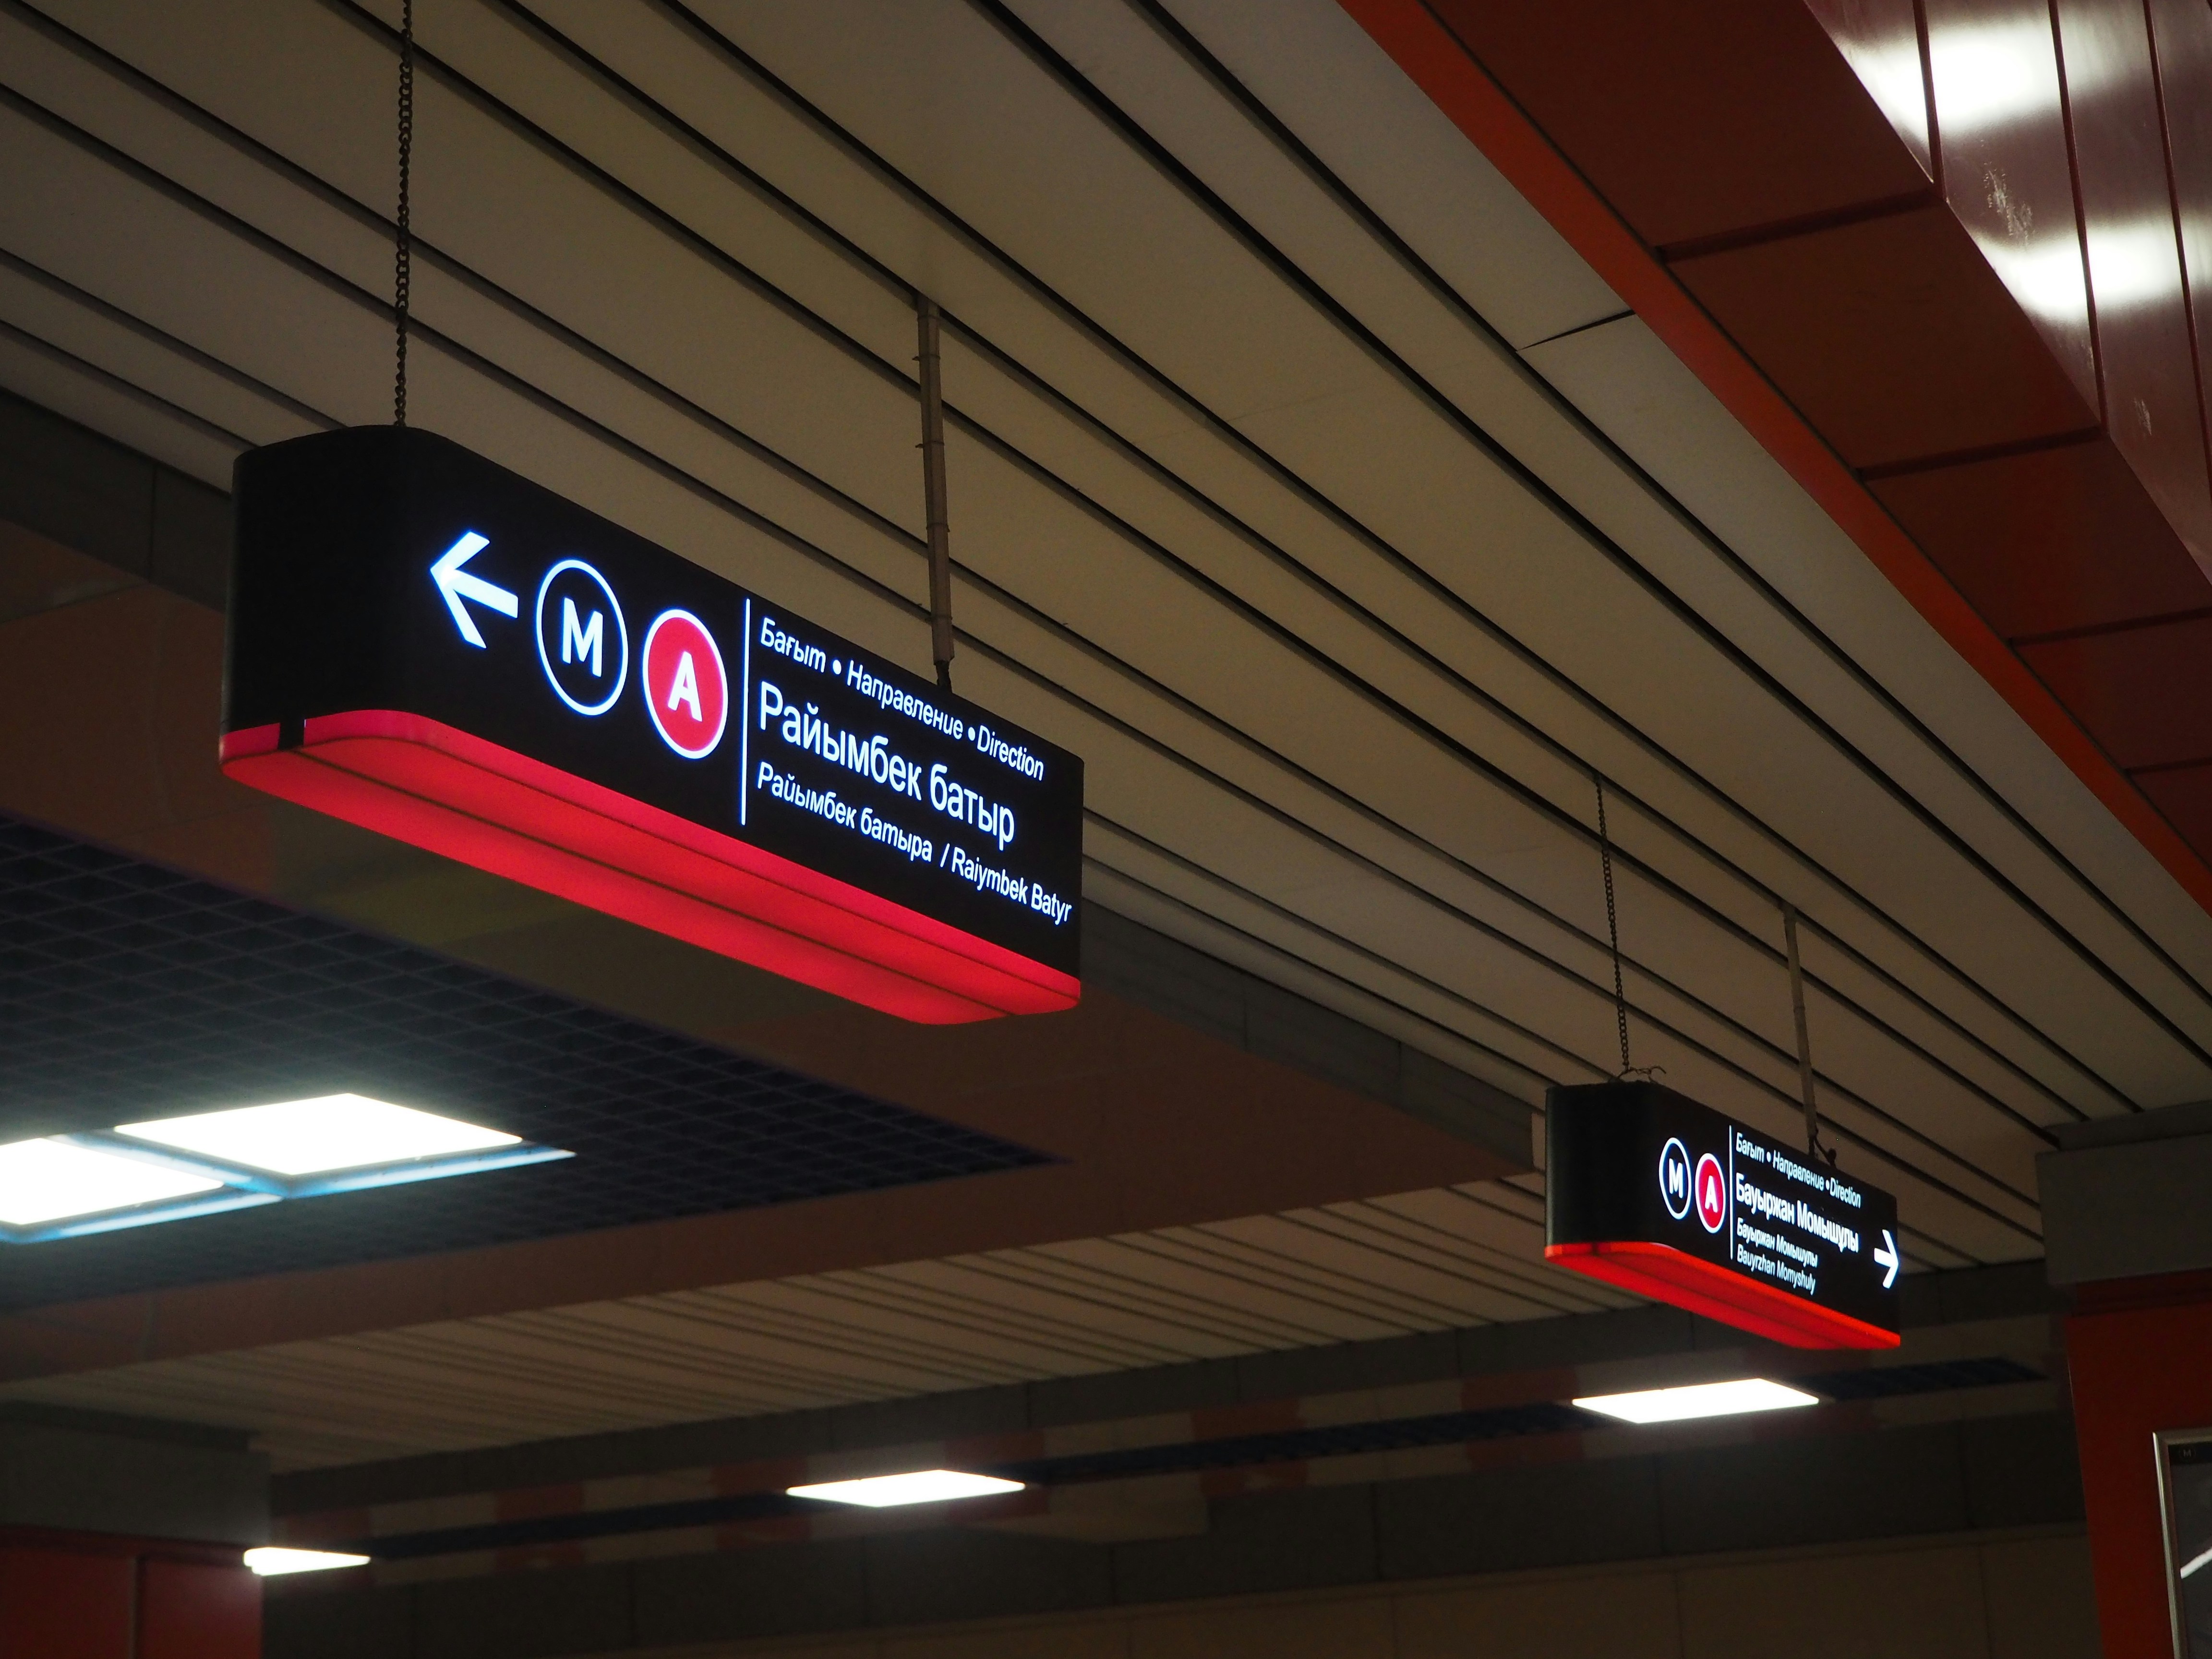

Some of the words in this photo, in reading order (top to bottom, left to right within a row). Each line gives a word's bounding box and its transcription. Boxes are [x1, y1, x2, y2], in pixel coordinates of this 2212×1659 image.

[761, 617, 827, 673] Бағыт
[847, 660, 963, 740] Направление
[977, 725, 1045, 781] Direction
[760, 681, 922, 800] Райымбек
[930, 764, 1015, 851] батыр
[757, 762, 857, 829] Райымбек
[860, 808, 933, 862] батыра
[952, 847, 1028, 904] Raiymbek
[1031, 883, 1072, 925] Batyr
[1736, 1132, 1764, 1163] Бағыт
[1773, 1150, 1824, 1191] Направление
[1830, 1177, 1861, 1209] Direction
[1736, 1173, 1794, 1225] Бауыржан
[1737, 1217, 1775, 1250] Бауыржан
[1776, 1234, 1818, 1268] Момышулы
[1737, 1244, 1775, 1274] Bauyrzhan
[1777, 1261, 1816, 1296] Momyshuly
